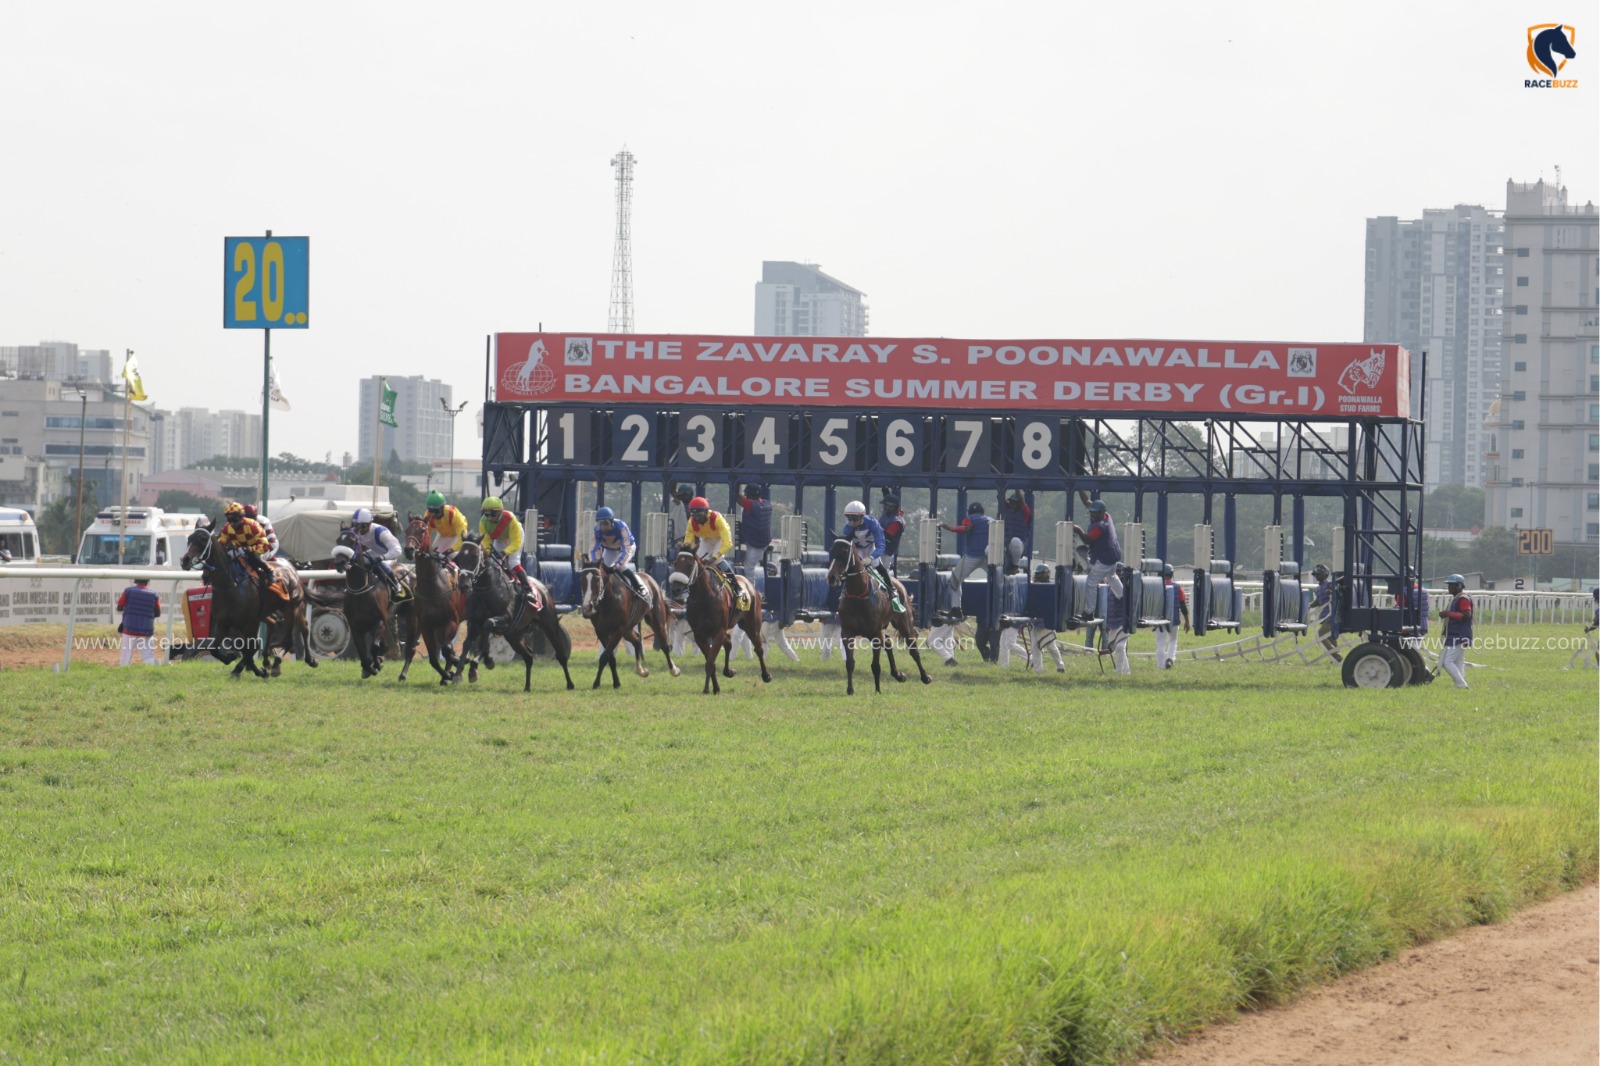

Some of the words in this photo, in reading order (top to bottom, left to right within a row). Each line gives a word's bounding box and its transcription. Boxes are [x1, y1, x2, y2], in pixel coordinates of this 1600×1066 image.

[597, 340, 683, 361] THE
[696, 341, 898, 363] ZAVARAY
[912, 344, 950, 364] S.
[967, 345, 1281, 370] POONAWALLA
[565, 374, 830, 397] BANGALORE
[844, 378, 1038, 400] SUMMER
[1053, 381, 1205, 403] DERBY
[1338, 395, 1383, 404] POONAWALLA
[1340, 404, 1357, 412] STUD
[1358, 404, 1381, 413] FARMS
[559, 412, 575, 460] 1
[620, 414, 650, 462] 2
[686, 414, 716, 463] 3
[752, 416, 781, 464] 4
[818, 417, 849, 466] 5
[885, 418, 915, 467] 6
[954, 420, 984, 468] 7
[1022, 421, 1052, 470] 8
[1520, 531, 1552, 554] 200
[30, 591, 48, 604] MUSIC
[63, 591, 80, 605] CA
[80, 592, 99, 605] MUSIC
[1515, 578, 1525, 590] 2
